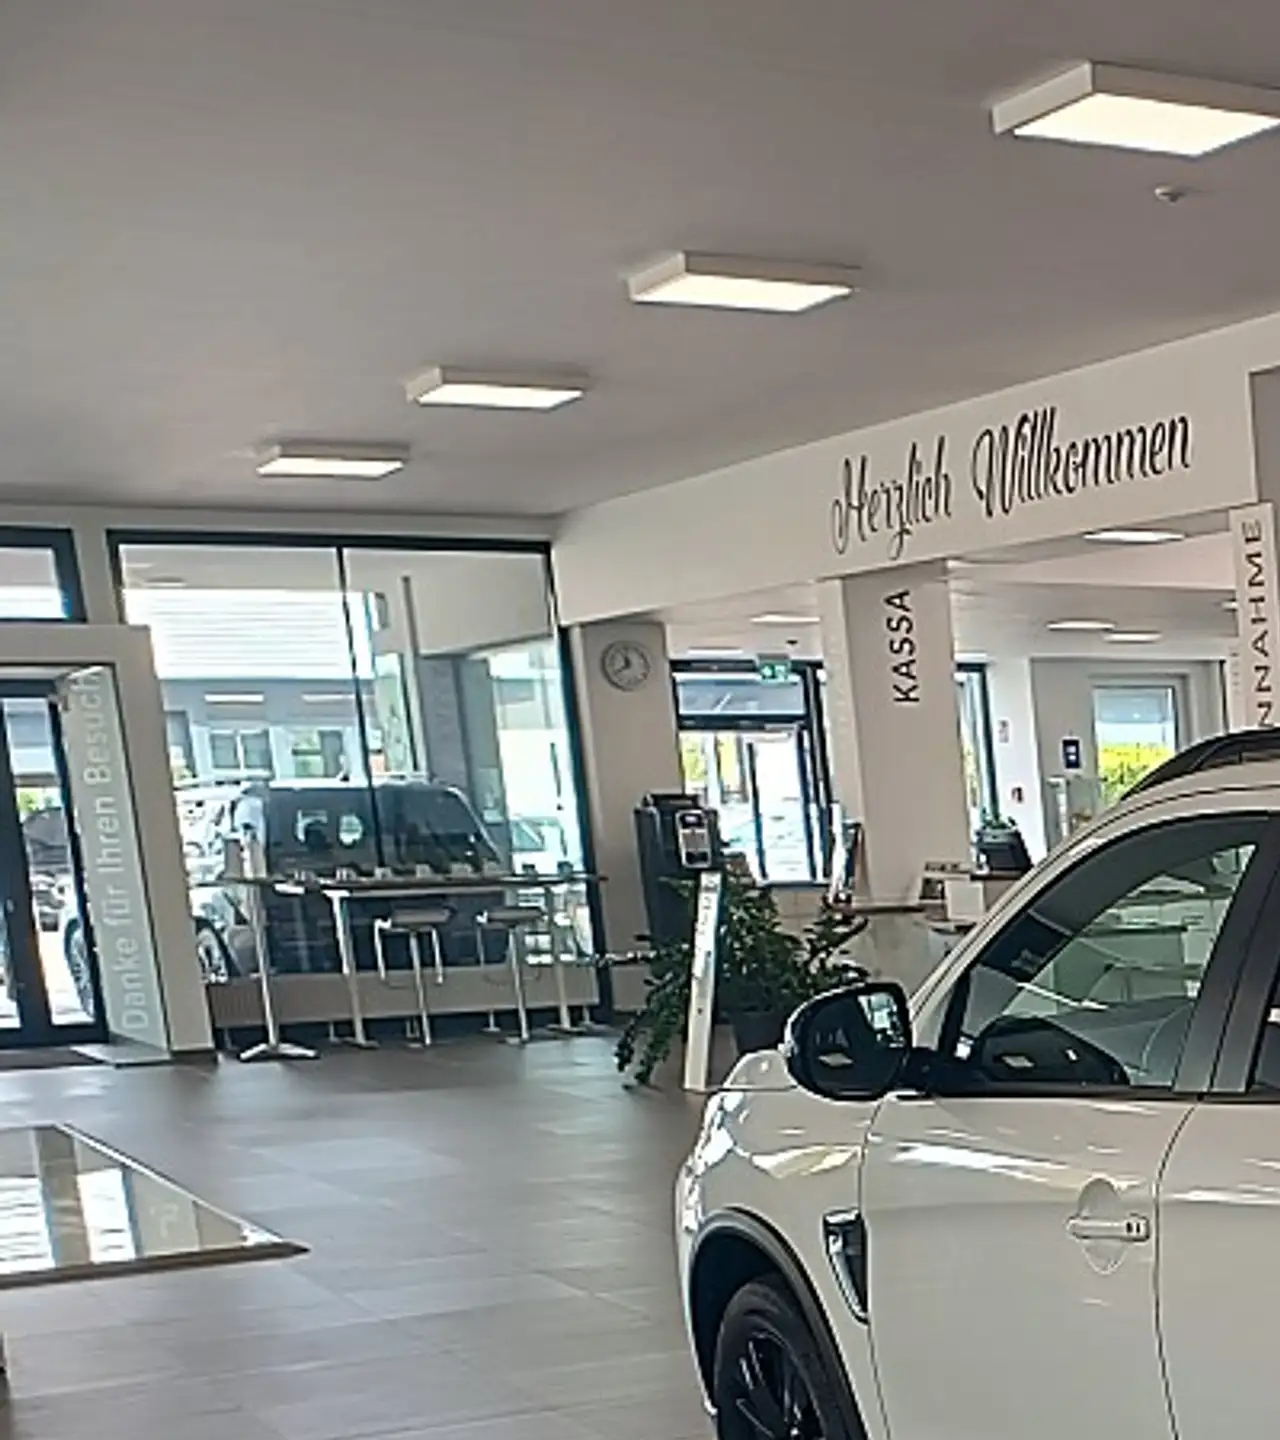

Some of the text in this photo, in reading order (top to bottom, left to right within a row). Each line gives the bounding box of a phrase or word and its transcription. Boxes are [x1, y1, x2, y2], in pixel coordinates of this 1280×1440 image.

[832, 406, 1191, 560] Herzlich Willkommen
[884, 590, 920, 703] KASSA
[96, 797, 124, 873] Ihren
[103, 884, 131, 926] für
[112, 936, 149, 1031] Danke
